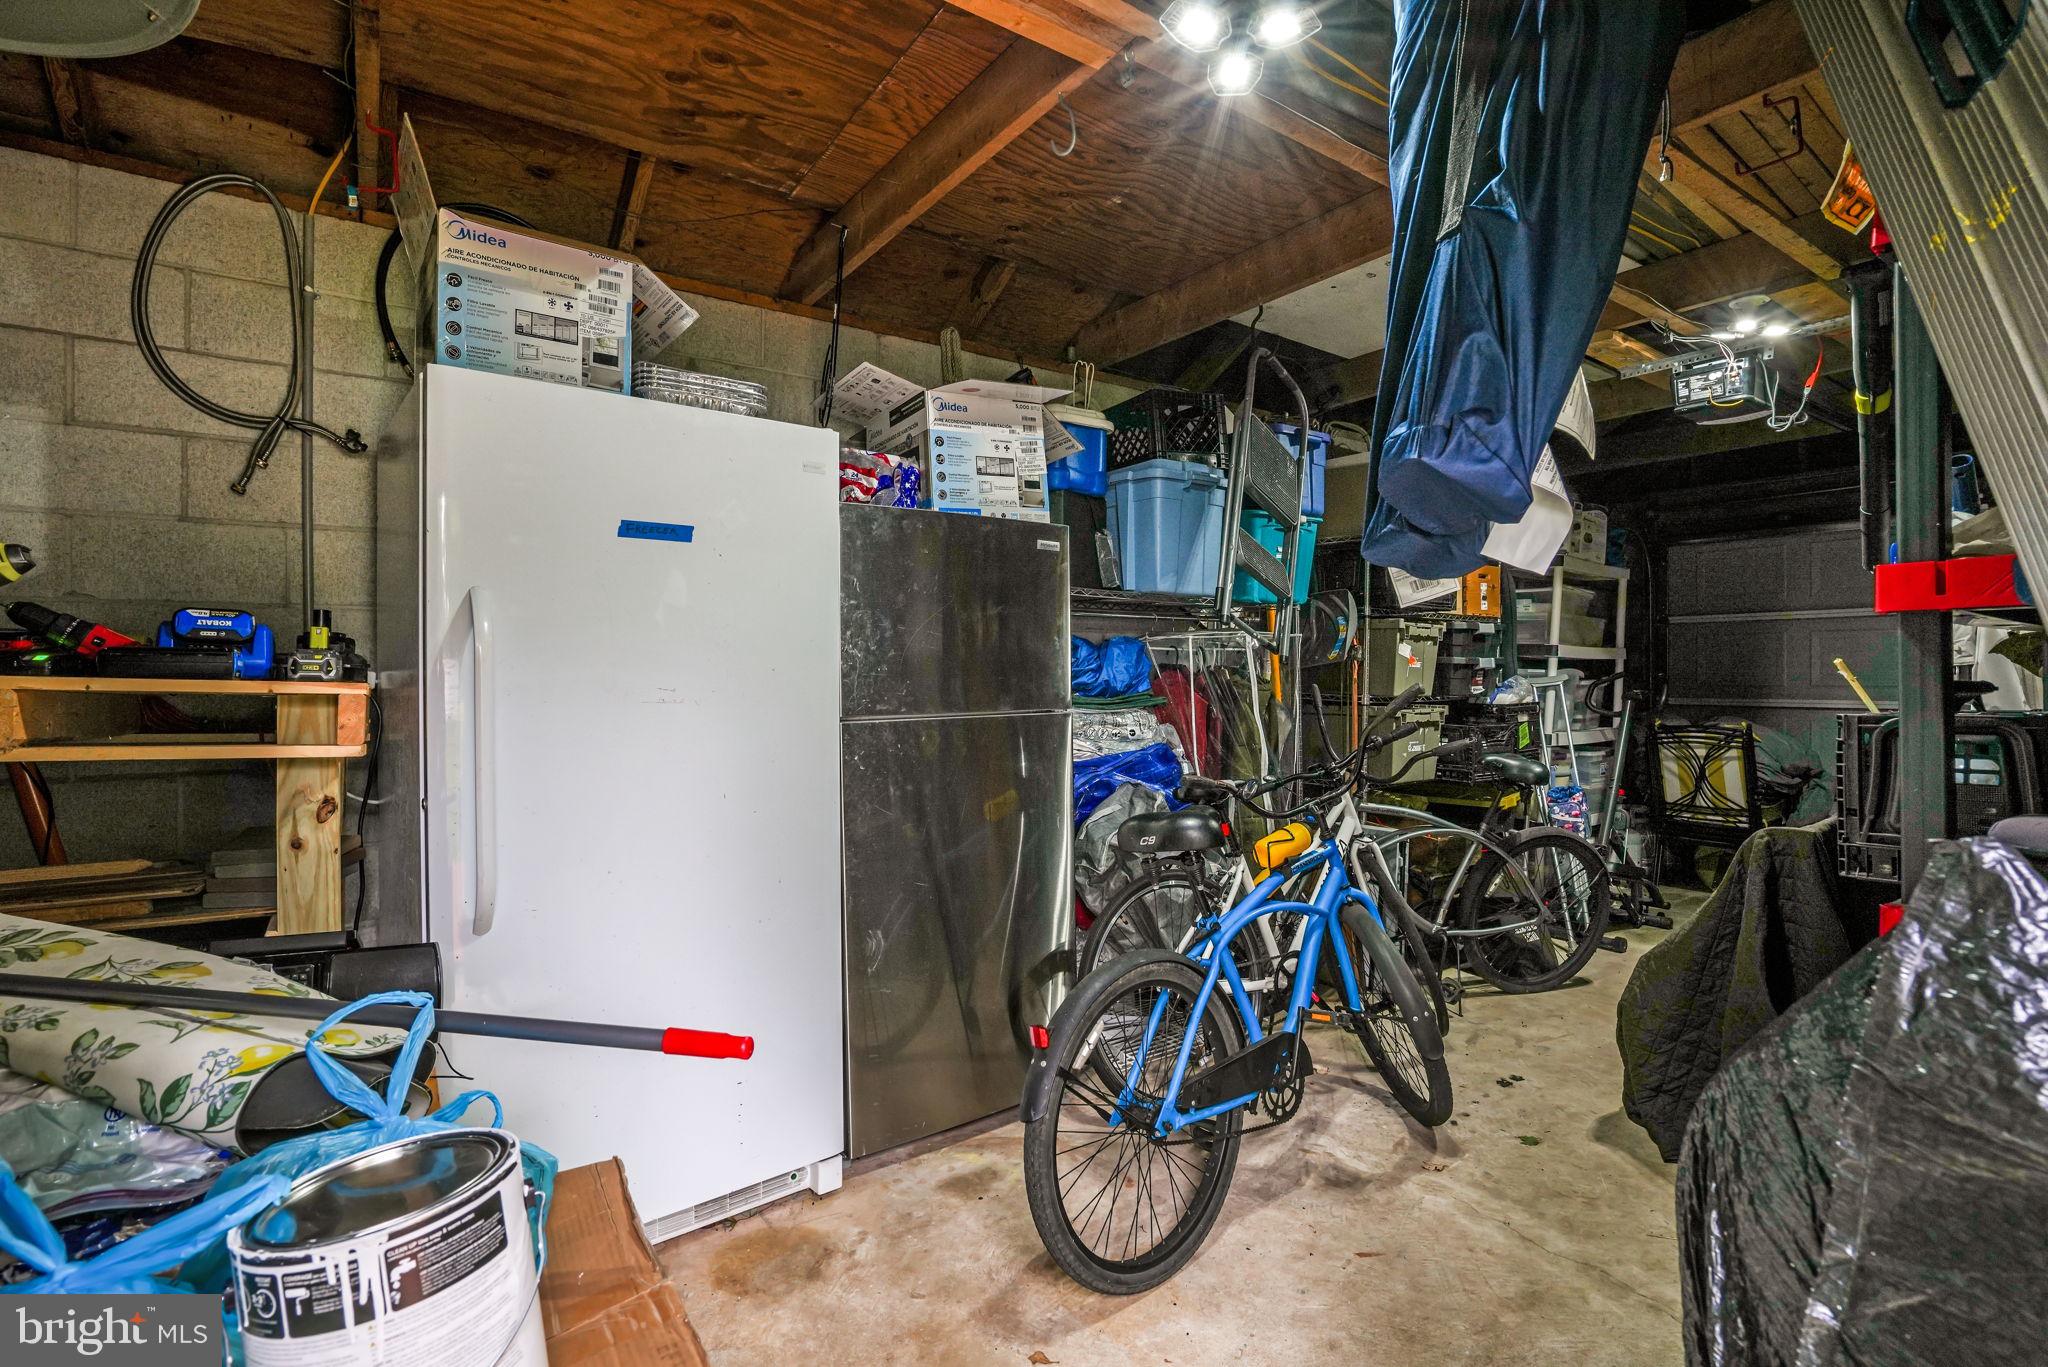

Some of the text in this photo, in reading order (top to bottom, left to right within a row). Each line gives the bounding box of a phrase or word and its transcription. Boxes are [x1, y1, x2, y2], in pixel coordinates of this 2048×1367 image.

[447, 220, 507, 248] Midea
[447, 247, 580, 282] AIRE ACONDICIONADO DE HABITACIÓN
[933, 397, 968, 412] Midea
[1140, 836, 1156, 846] C9
